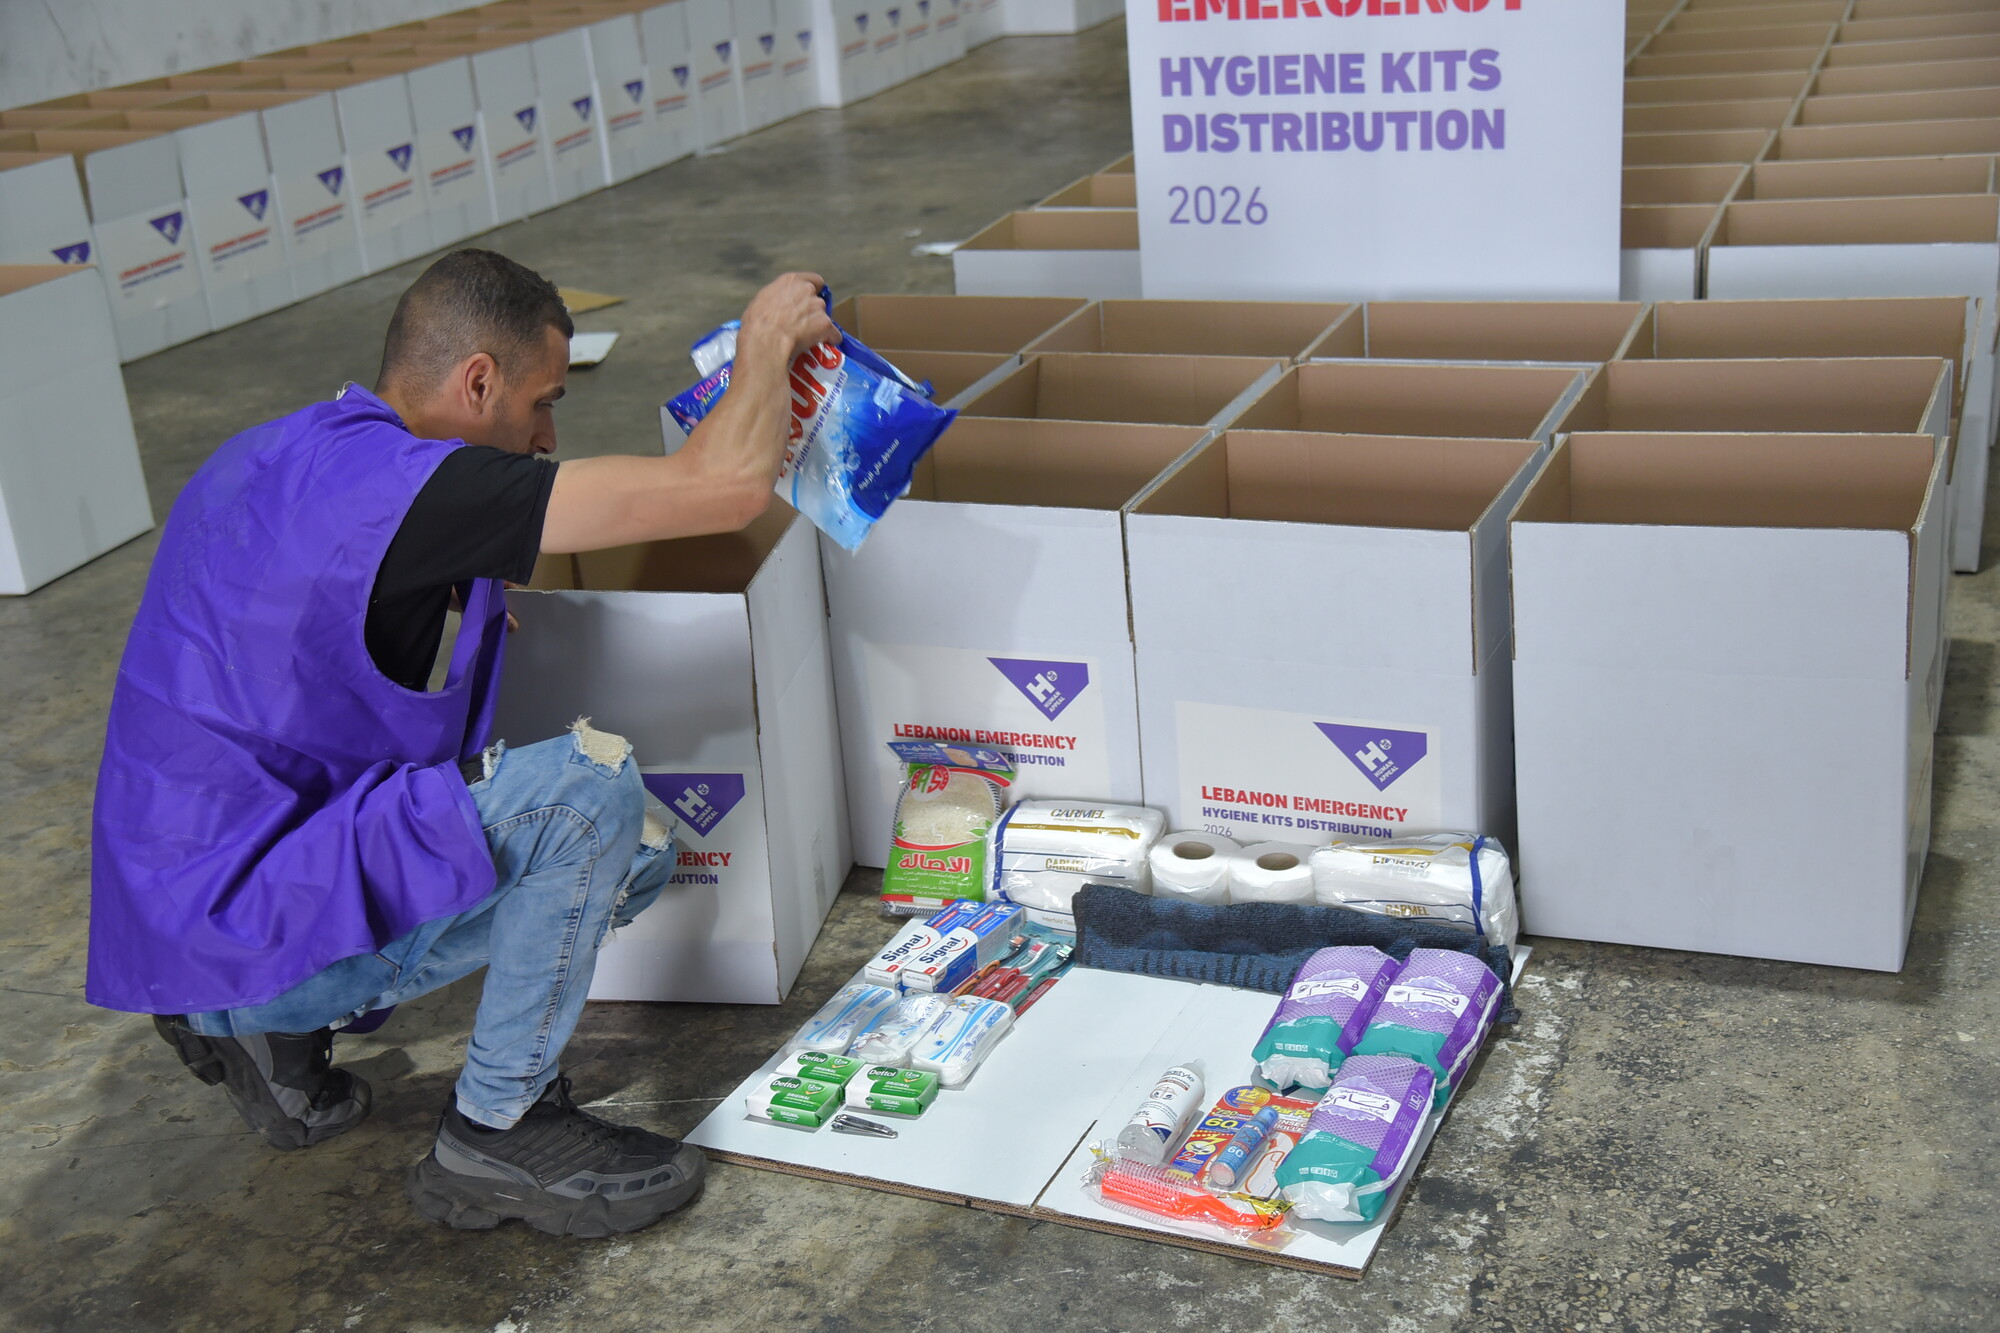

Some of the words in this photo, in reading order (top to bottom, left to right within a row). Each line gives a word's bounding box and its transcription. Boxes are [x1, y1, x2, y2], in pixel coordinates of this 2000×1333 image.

[1160, 53, 1366, 97] HYGIENE
[1381, 49, 1502, 95] KITS
[1162, 108, 1505, 153] DISTRIBUTION
[1168, 185, 1268, 225] 2026
[893, 723, 971, 743] LEBANON
[975, 729, 1077, 751] EMERGENCY
[1201, 785, 1288, 809] LEBANON
[1293, 796, 1408, 823] EMERGENCY
[694, 805, 713, 824] HUMAN
[699, 810, 719, 829] APPEAL
[1202, 807, 1258, 823] HYGIENE
[1262, 814, 1293, 827] KITS
[1296, 818, 1392, 838] DISTRIBUTION
[1203, 823, 1233, 838] 2026
[898, 853, 972, 874] الأصالة
[881, 934, 924, 962] Signal
[919, 936, 961, 964] Signal
[800, 1053, 827, 1064] Dettol
[869, 1068, 896, 1077] Dettol
[773, 1080, 799, 1089] Dettol
[1237, 1088, 1258, 1099] 12
[1205, 1118, 1239, 1129] 60
[1227, 1145, 1244, 1158] 60
